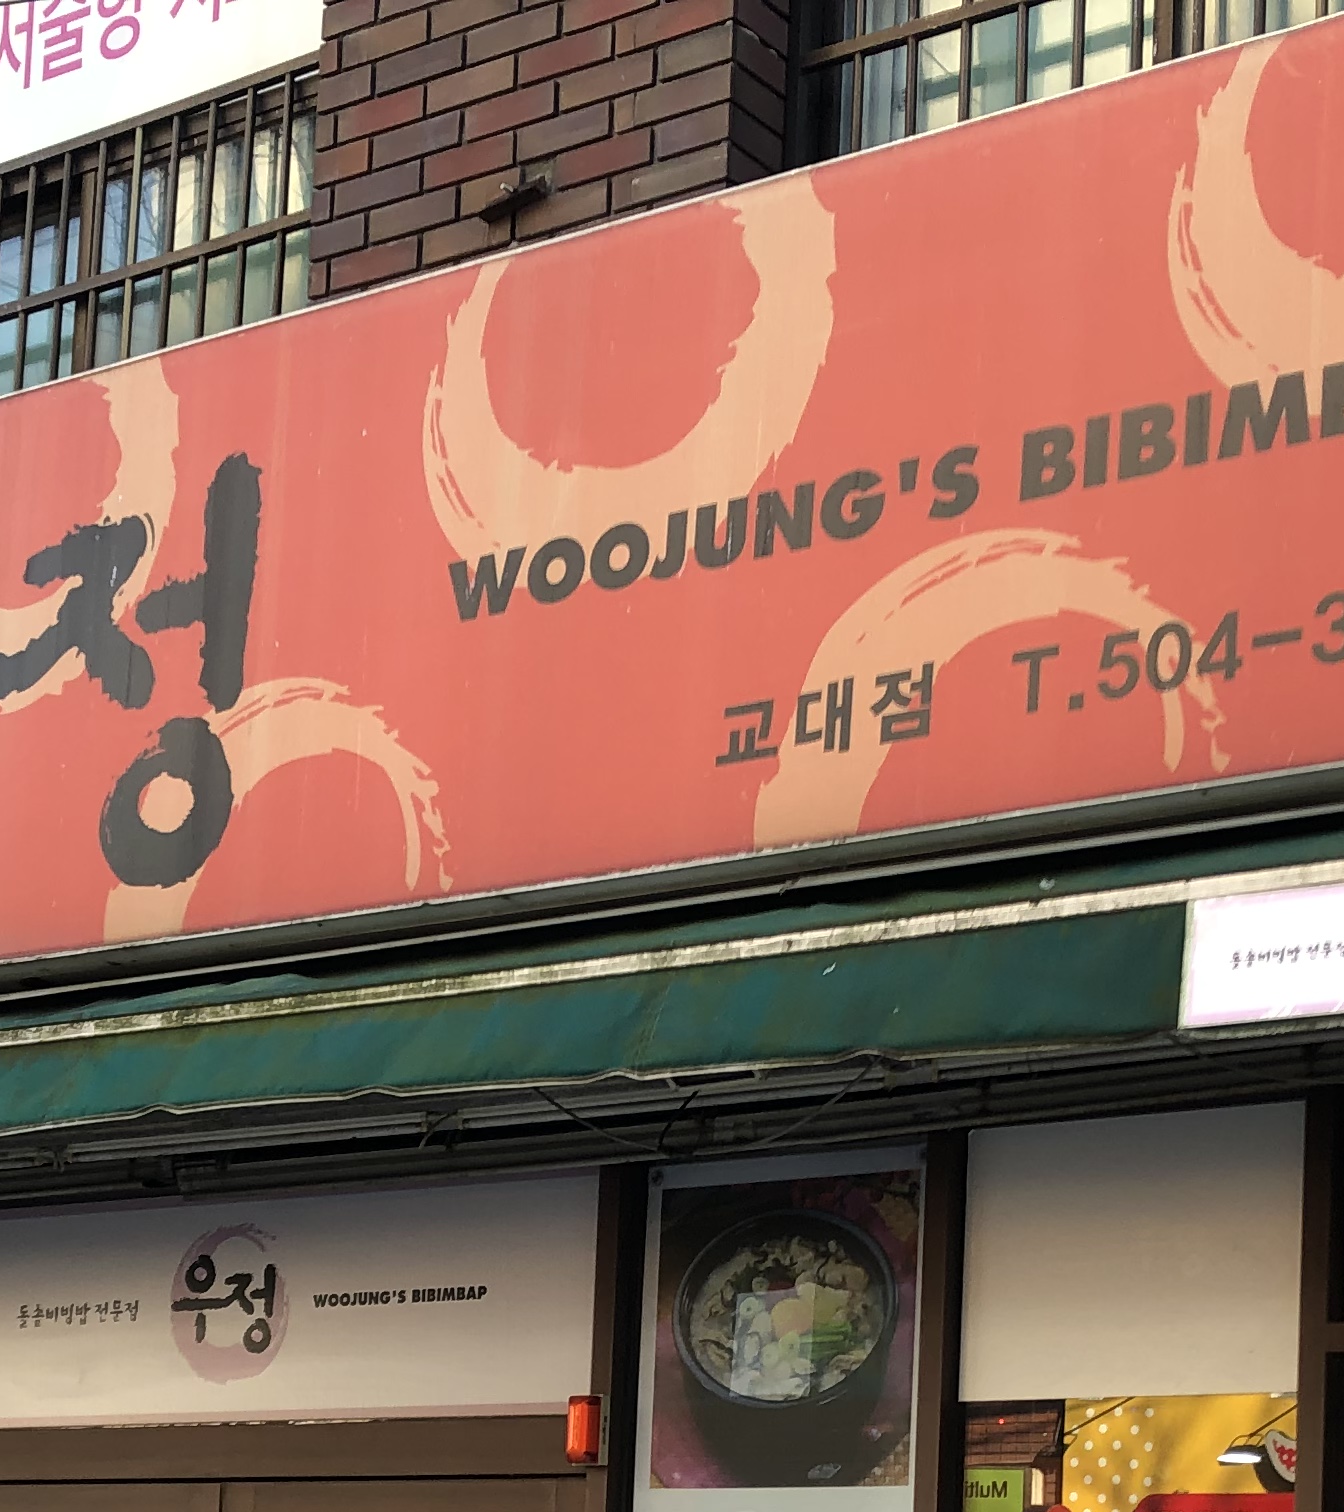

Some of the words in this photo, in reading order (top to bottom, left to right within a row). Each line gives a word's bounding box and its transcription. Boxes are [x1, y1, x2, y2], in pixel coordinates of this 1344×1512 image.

[447, 445, 981, 622] WOOJUNG'S
[715, 661, 935, 768] 교대점
[171, 1255, 277, 1354] 우정
[313, 1289, 407, 1309] WOOJUNG'S
[411, 1285, 488, 1304] BIBIMBAP
